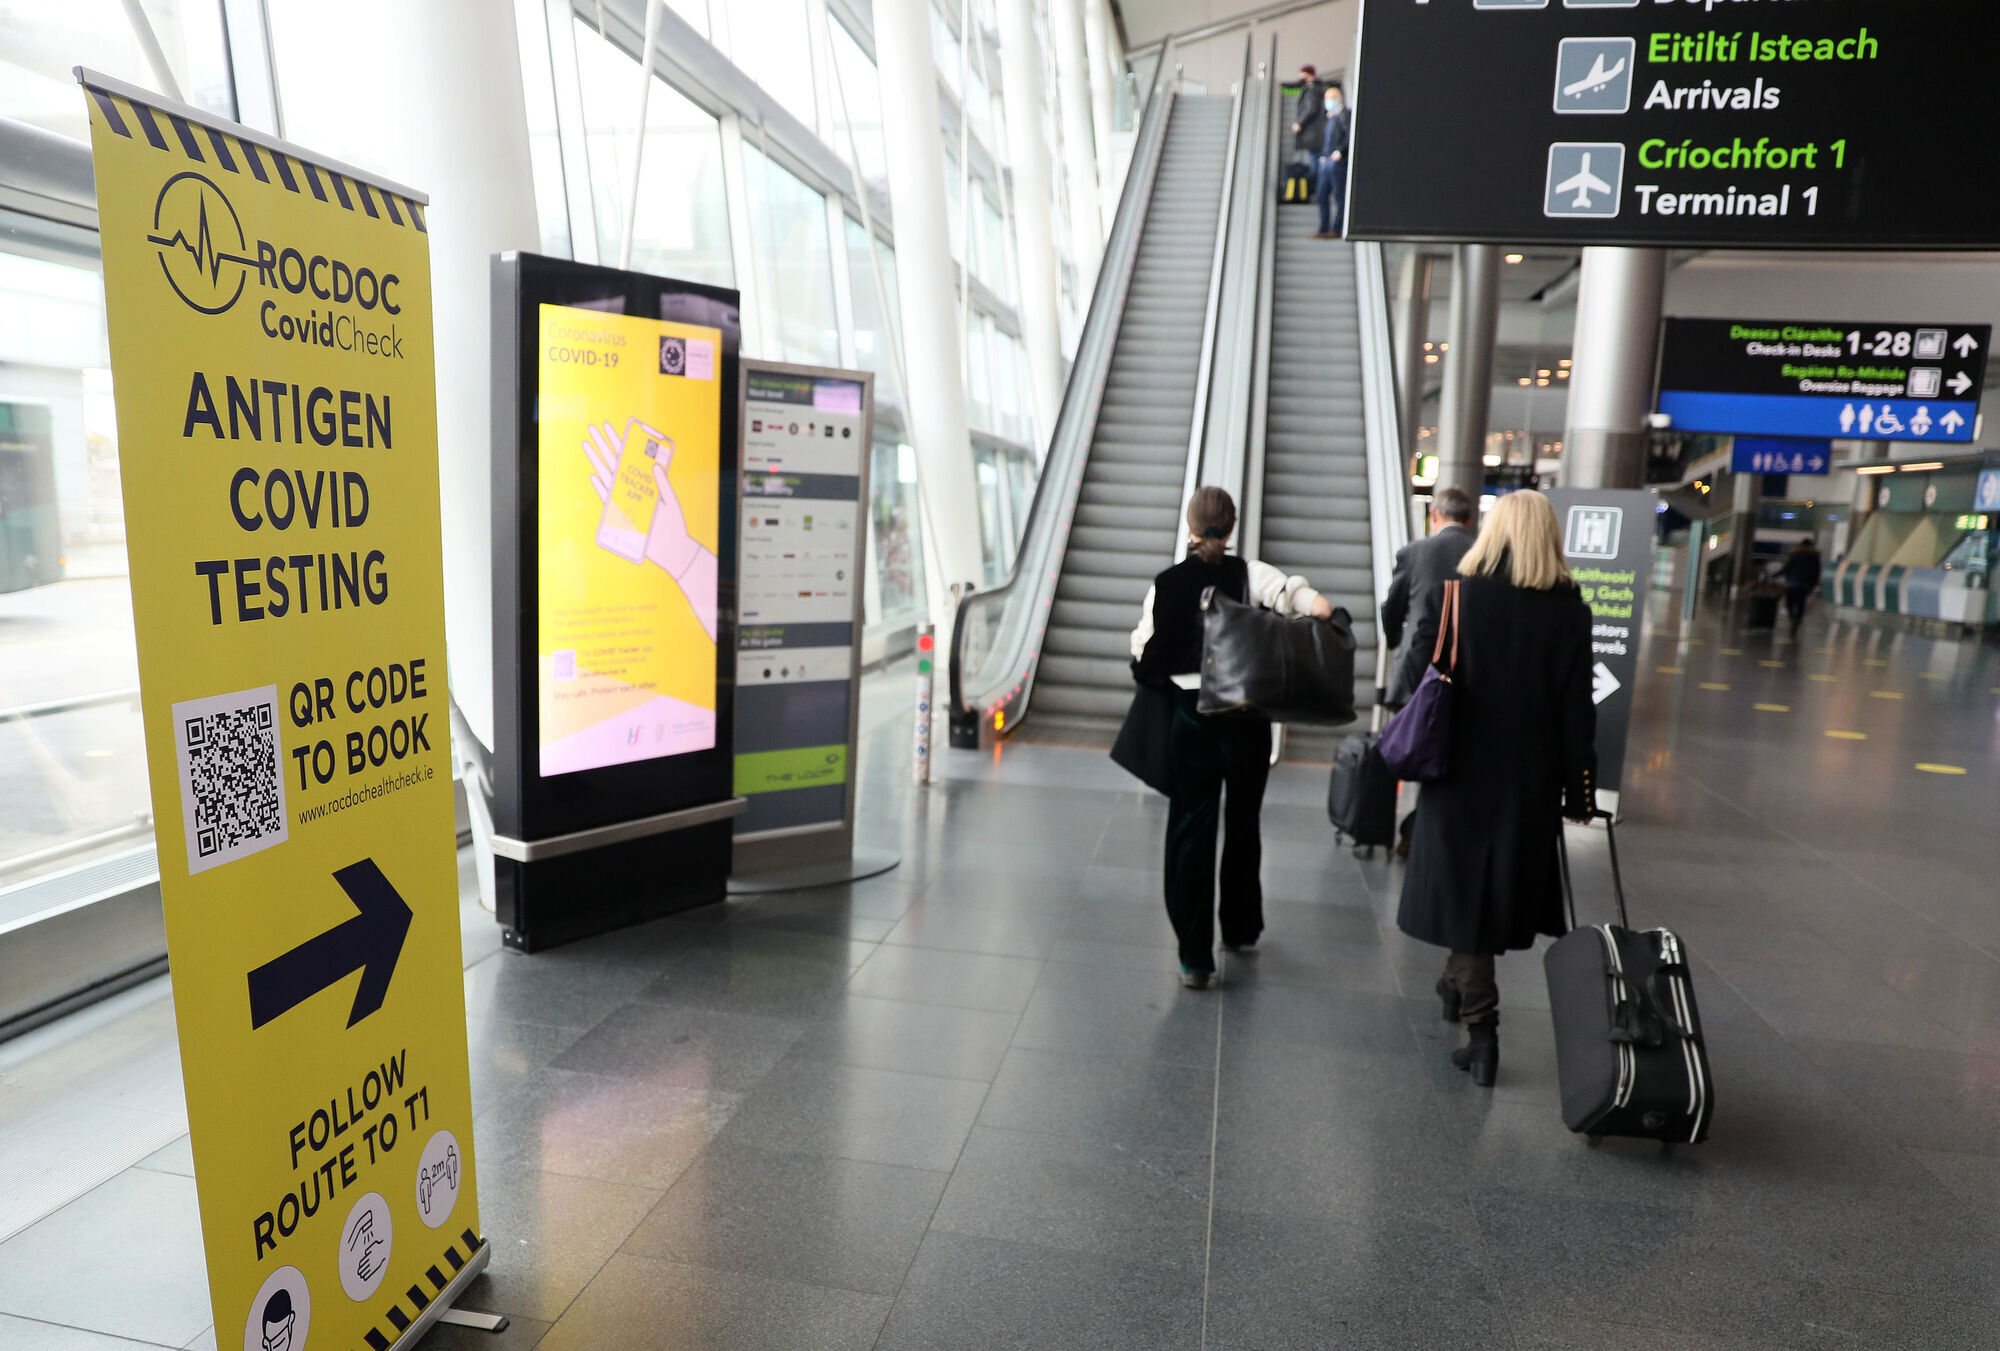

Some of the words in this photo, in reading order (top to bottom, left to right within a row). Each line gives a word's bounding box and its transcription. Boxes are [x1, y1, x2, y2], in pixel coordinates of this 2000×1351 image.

[1648, 31, 1743, 62] Eitiltí
[1750, 27, 1878, 62] Isteach
[1643, 77, 1781, 110] Arrivals
[1638, 137, 1818, 169] Críochfort
[1830, 139, 1846, 169] 1
[1634, 184, 1790, 216] Terminal
[1802, 186, 1819, 216] 1
[257, 239, 401, 315] ROCDOC
[260, 300, 404, 359] CovidCheck
[548, 322, 626, 348] Coronavirus
[1846, 330, 1912, 357] 1-28
[548, 346, 619, 368] COVID-19
[1746, 341, 1801, 356] Check-in
[1802, 343, 1842, 358] Desks
[1799, 378, 1850, 393] Oversize
[1851, 381, 1905, 397] Baggage
[183, 371, 392, 450] ANTIGEN
[230, 467, 369, 532] COVID
[195, 550, 388, 625] TESTING
[1597, 585, 1634, 601] Gach
[1592, 624, 1629, 639] ators
[1592, 640, 1627, 655] evels
[290, 678, 336, 728] QR
[346, 659, 427, 713] CODE
[292, 740, 336, 791] TO
[346, 713, 431, 775] BOOK
[298, 764, 434, 825] www.rocdochealthcheck.ie
[289, 1049, 406, 1171] FOLLOW
[253, 1143, 358, 1261] ROUTE
[363, 1113, 398, 1165] TO
[404, 1086, 429, 1131] T1
[431, 1160, 445, 1178] 2m
